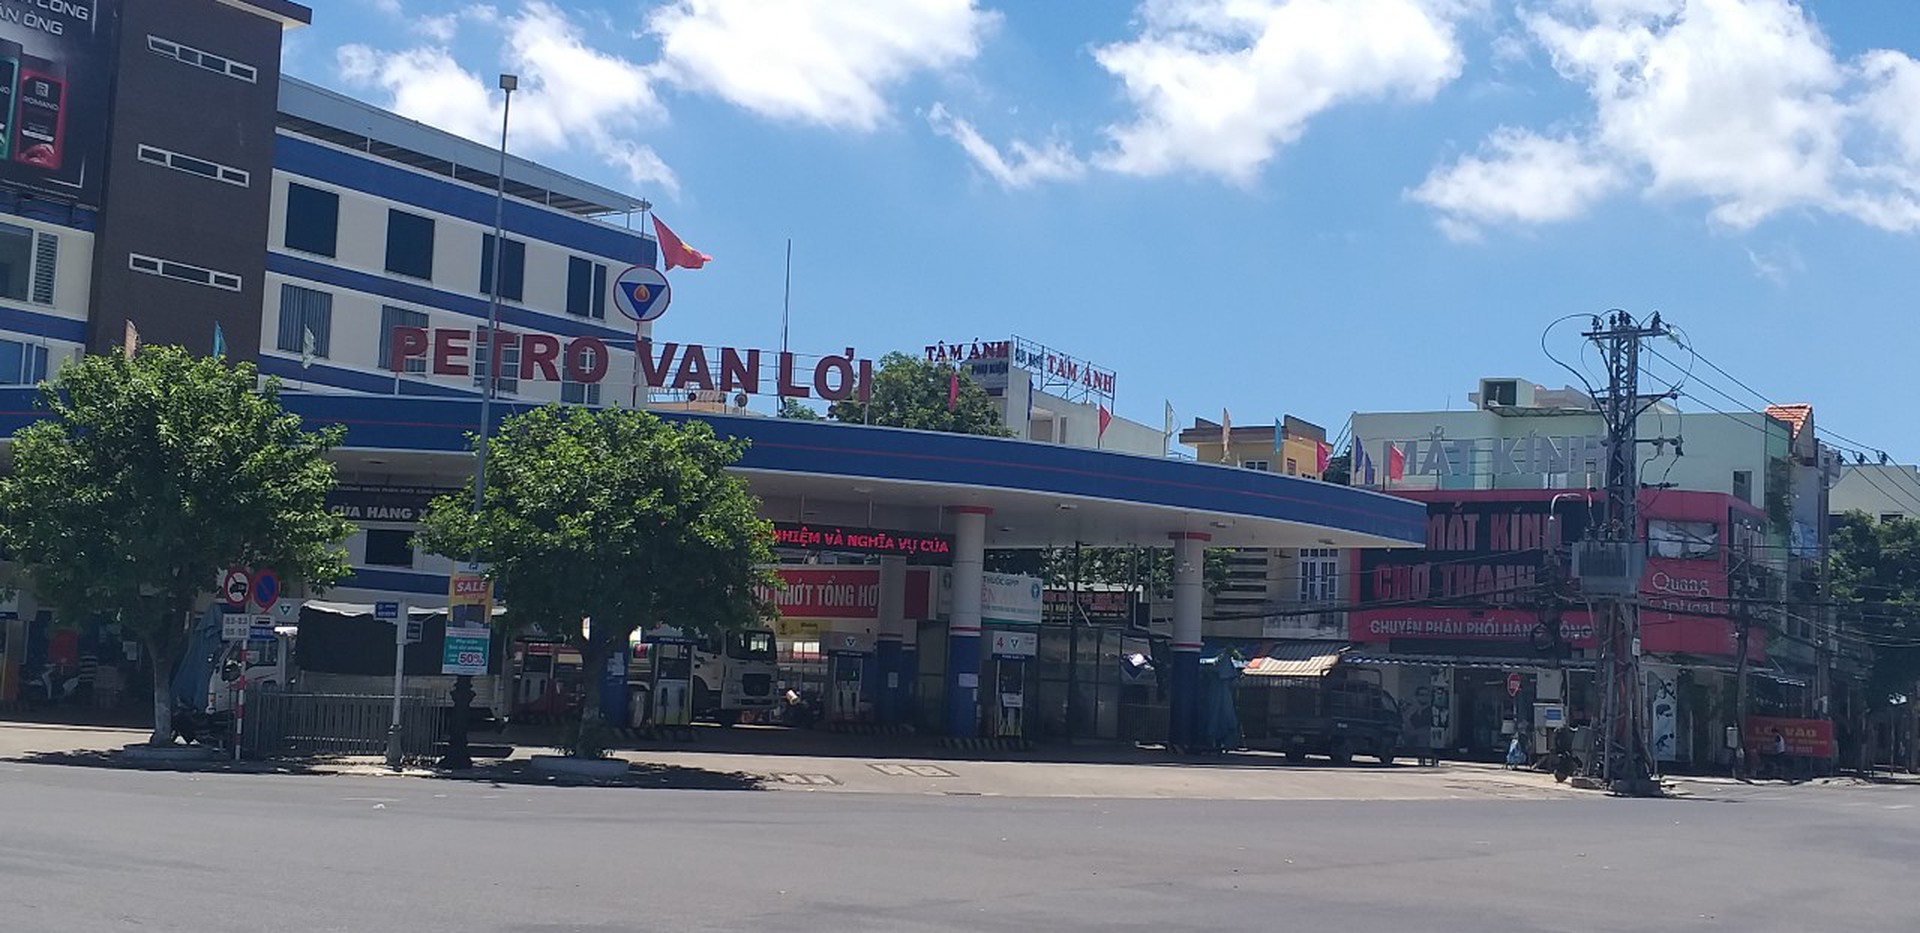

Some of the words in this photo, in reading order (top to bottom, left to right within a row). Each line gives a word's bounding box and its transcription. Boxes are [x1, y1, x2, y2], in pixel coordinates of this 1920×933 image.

[23, 10, 63, 35] ÔNG
[390, 326, 609, 384] PETRO
[925, 340, 963, 362] TÂM
[967, 337, 1010, 360] ÁNH
[1047, 352, 1078, 383] TÂM
[1082, 361, 1114, 393] ÁNH
[1493, 428, 1607, 475] KÍNH
[366, 504, 413, 519] HÀNG
[824, 528, 844, 546] VÀ
[456, 581, 488, 592] SALE
[816, 574, 855, 607] TỔNG
[858, 583, 880, 611] HỢ
[1652, 572, 1710, 598] Quang
[1426, 618, 1463, 635] PHÂN
[1466, 616, 1500, 637] PHỐI
[459, 653, 485, 664] 50%
